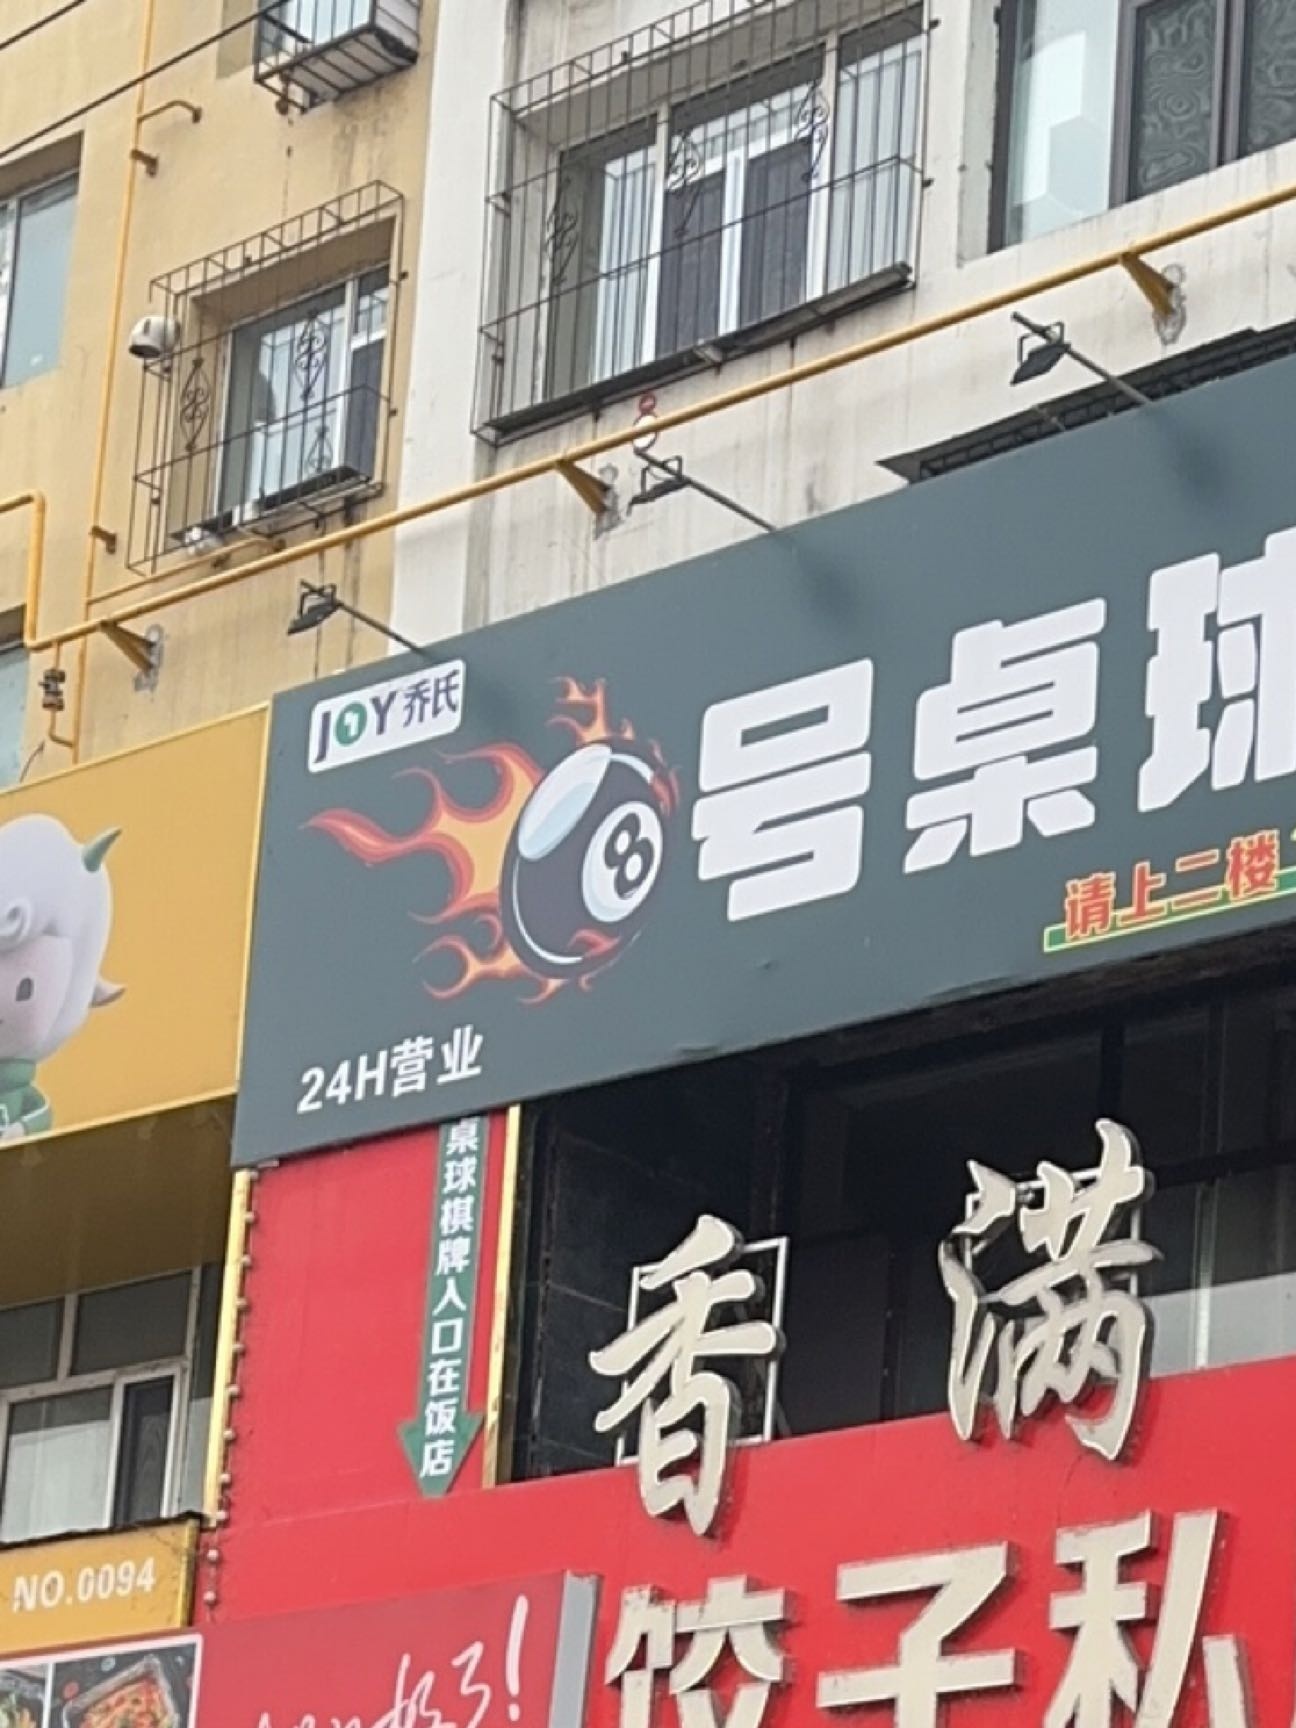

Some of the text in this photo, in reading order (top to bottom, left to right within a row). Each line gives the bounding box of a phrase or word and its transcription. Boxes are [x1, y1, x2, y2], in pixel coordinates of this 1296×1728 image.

[1064, 831, 1279, 941] 请上二楼
[297, 1025, 484, 1113] 24H营业
[12, 1557, 156, 1613] NO.0094
